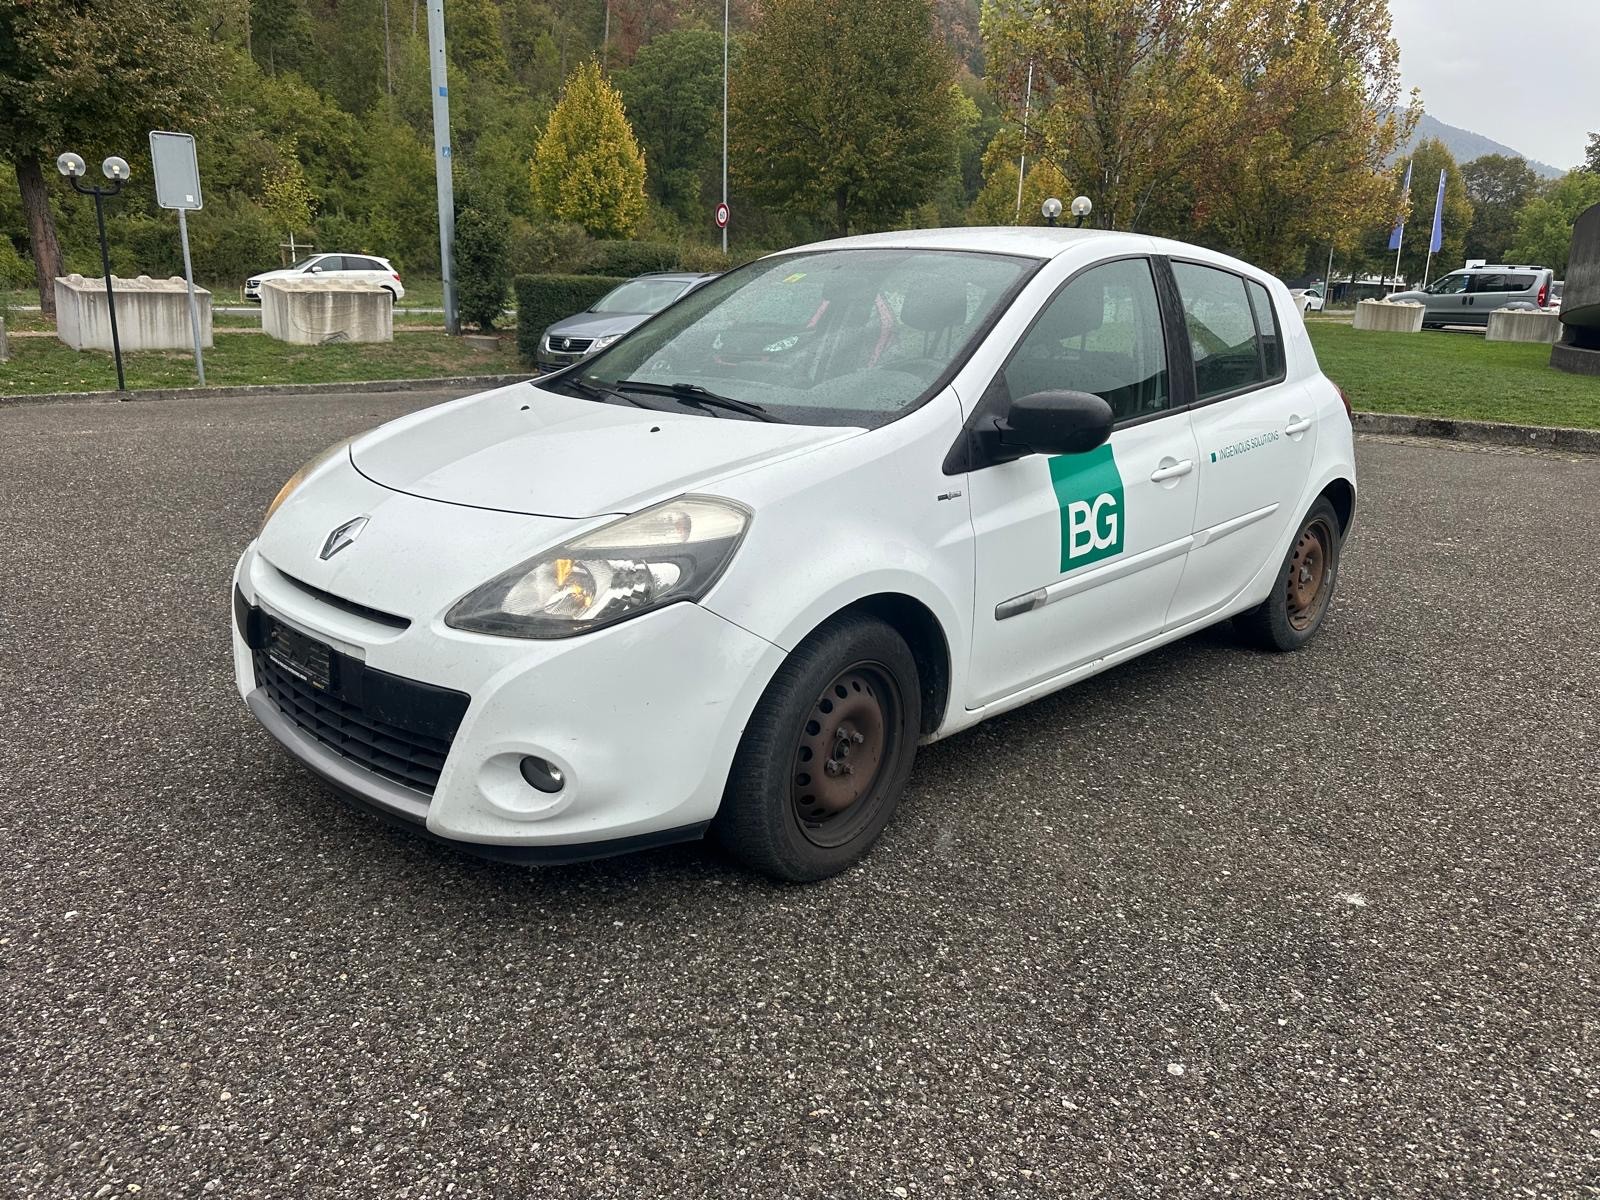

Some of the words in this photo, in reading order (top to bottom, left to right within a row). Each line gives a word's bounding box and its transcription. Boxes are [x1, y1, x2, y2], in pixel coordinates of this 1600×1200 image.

[1219, 440, 1250, 460] INGENIOUS
[1251, 430, 1279, 449] SOLUTIONS
[1068, 493, 1117, 559] BG
